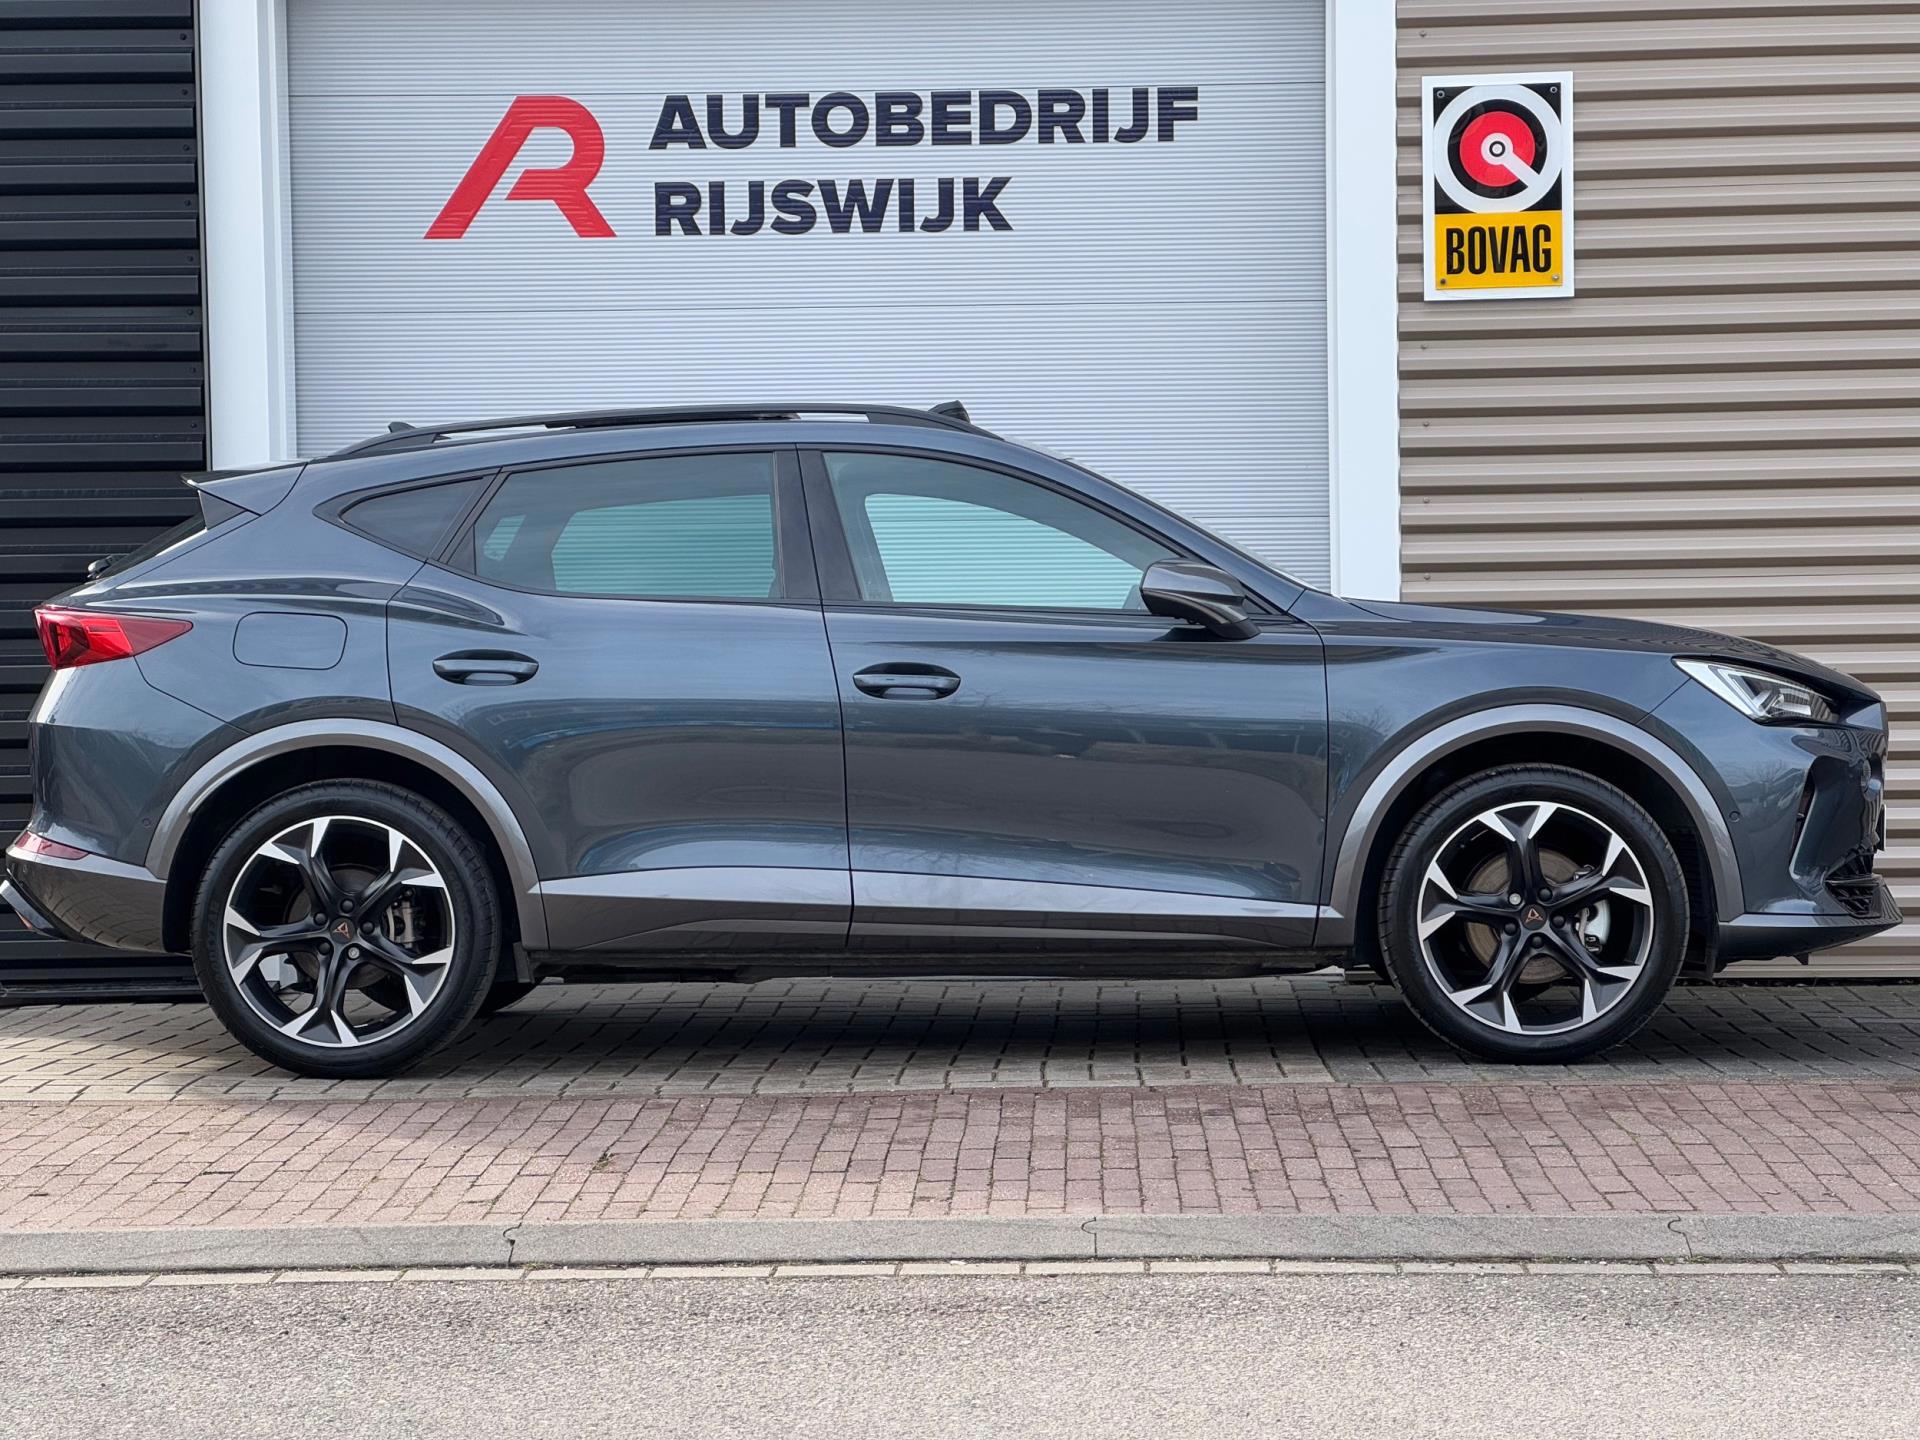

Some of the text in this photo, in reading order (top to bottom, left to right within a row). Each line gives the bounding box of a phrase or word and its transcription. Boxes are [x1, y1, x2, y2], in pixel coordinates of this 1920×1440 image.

[648, 86, 1199, 150] AUTOBEDRIJF
[654, 177, 1014, 237] RIJSWIJK
[1445, 224, 1552, 276] BOVAG
